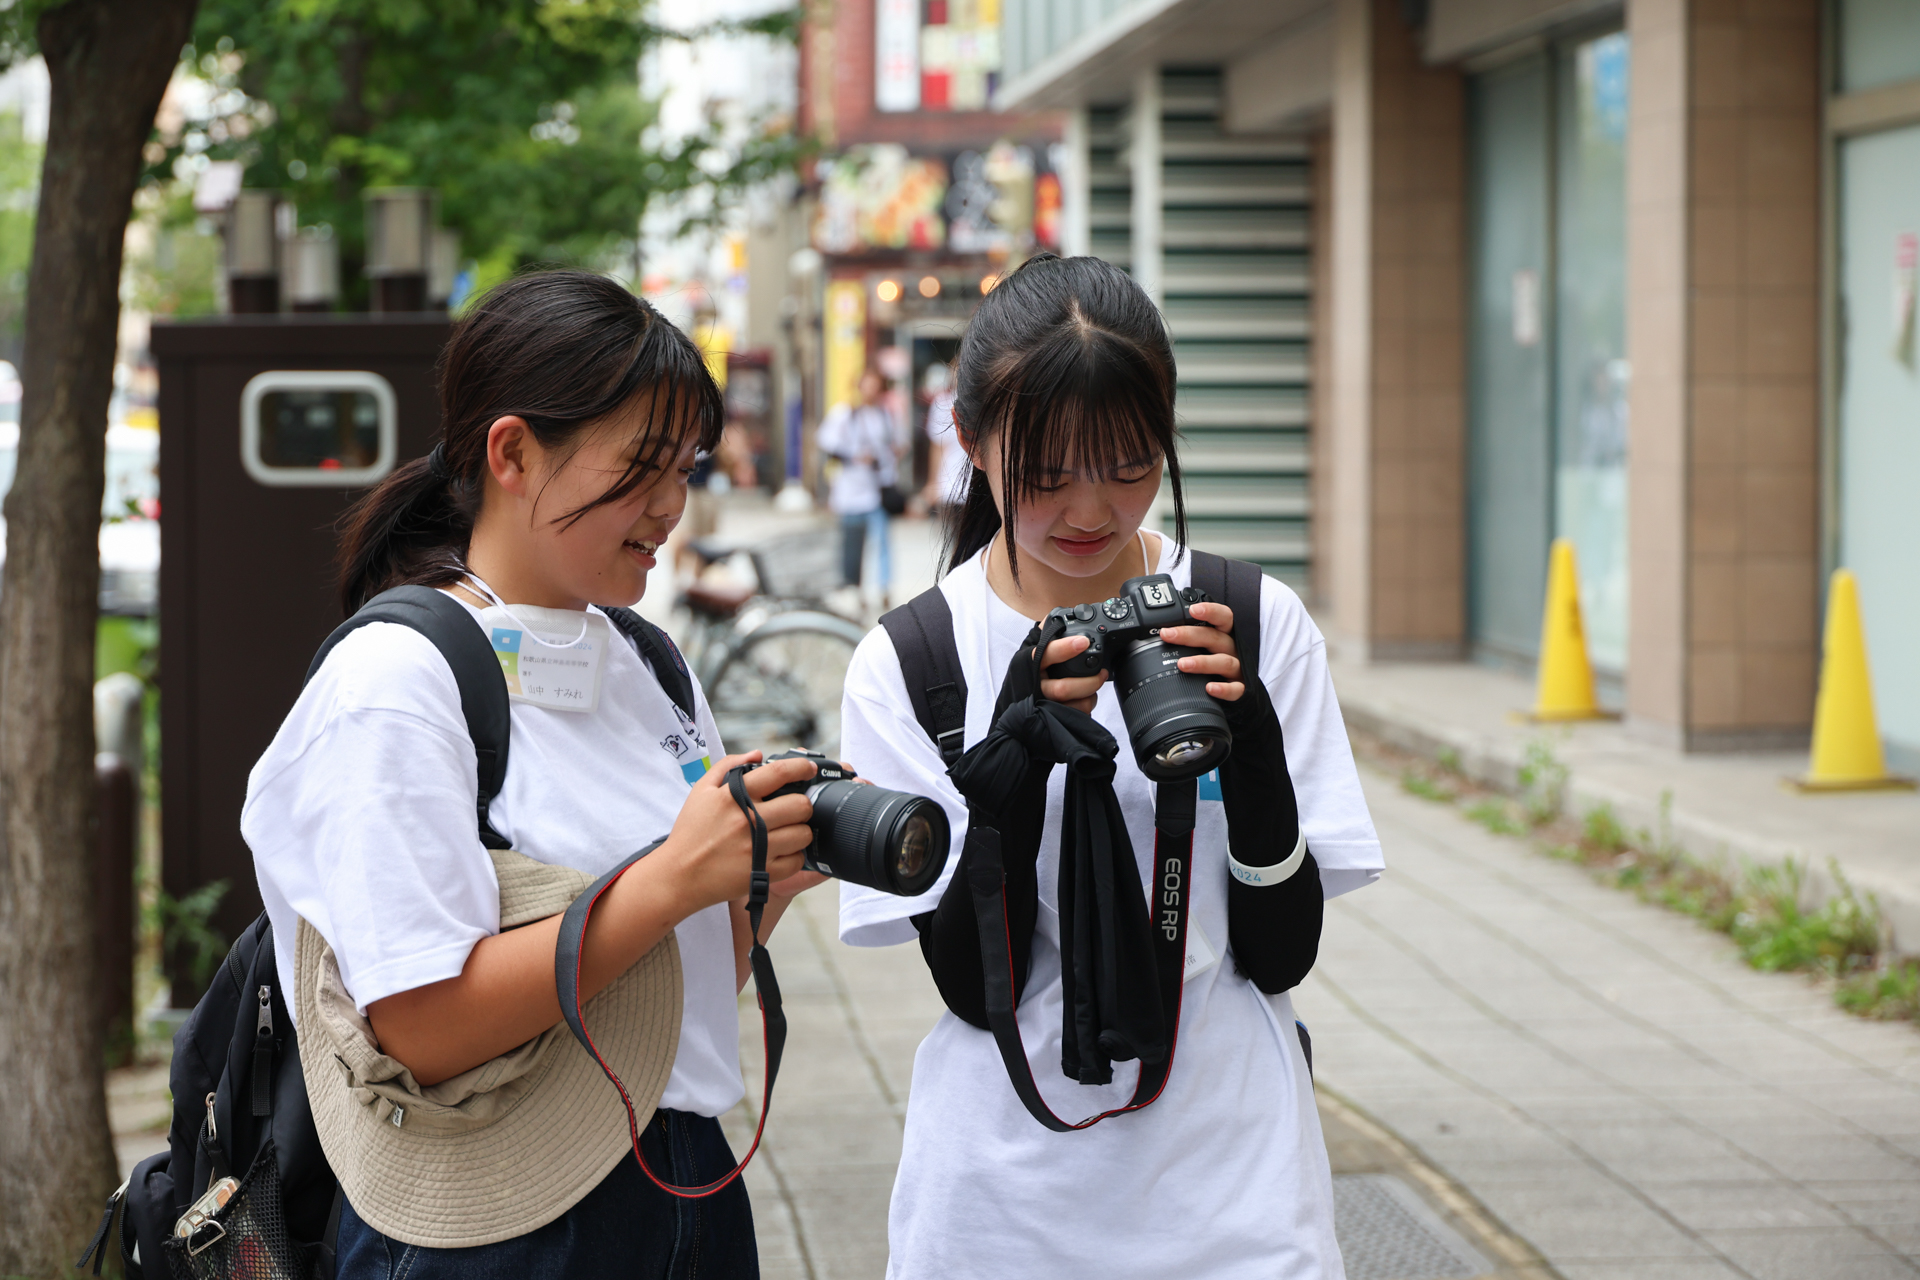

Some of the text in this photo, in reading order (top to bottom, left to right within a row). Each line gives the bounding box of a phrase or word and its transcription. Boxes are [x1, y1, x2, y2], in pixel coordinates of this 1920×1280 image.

[527, 685, 584, 699] 山中 すみれ
[821, 768, 842, 778] Canon
[1231, 863, 1262, 882] 2024
[1162, 858, 1181, 941] EOS RP
